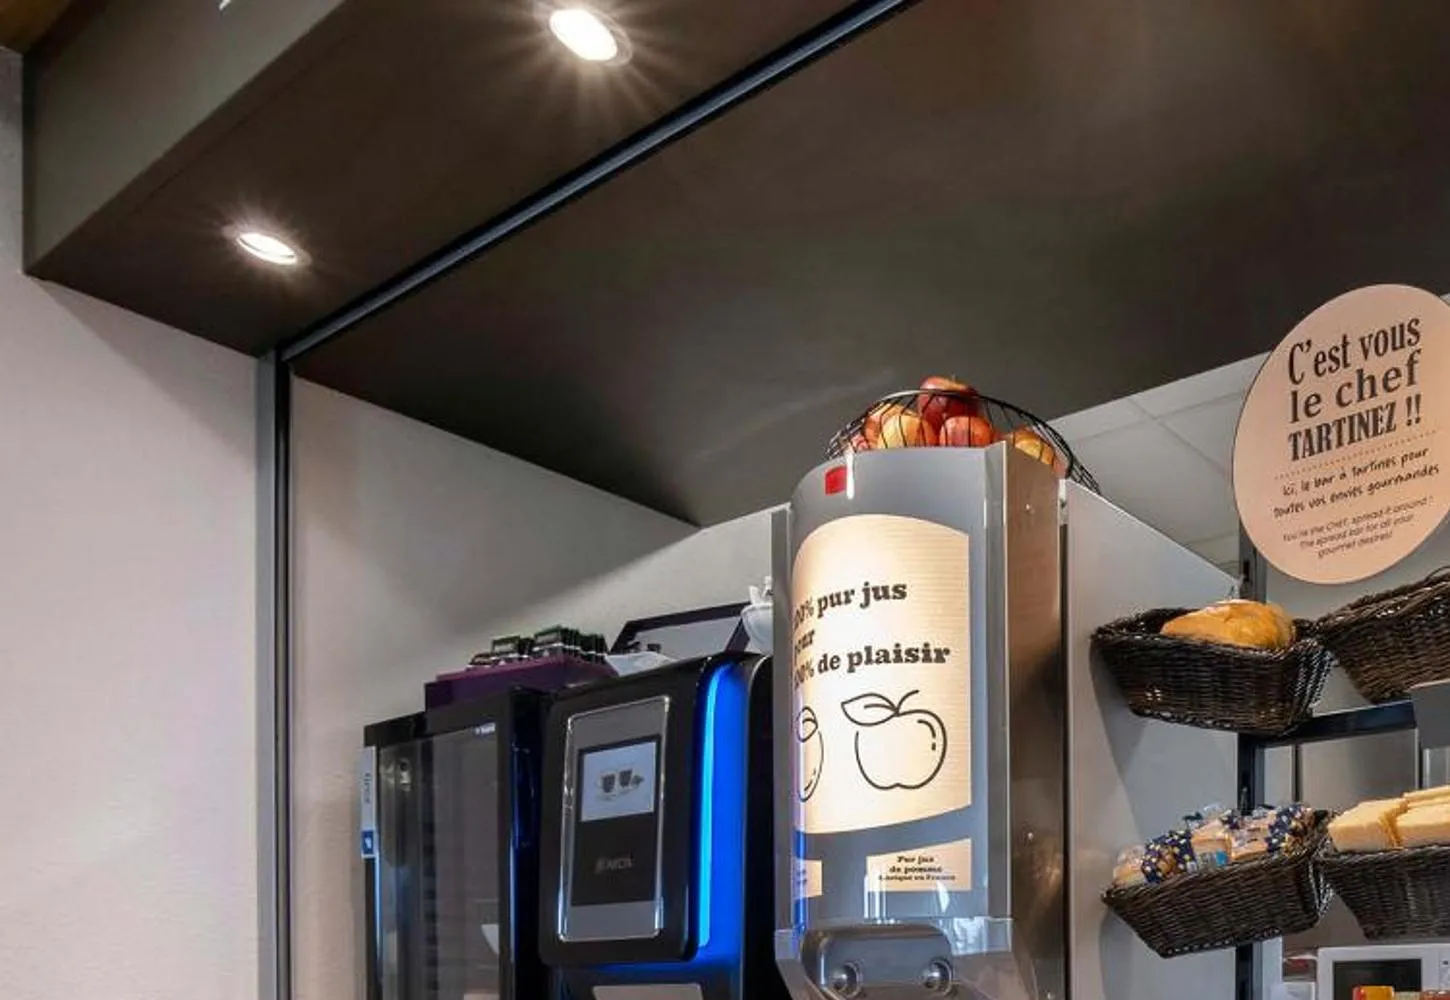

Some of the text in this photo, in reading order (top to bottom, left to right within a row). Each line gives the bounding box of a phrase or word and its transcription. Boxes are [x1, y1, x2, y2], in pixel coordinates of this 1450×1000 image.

[1358, 317, 1421, 361] vous
[1290, 348, 1422, 424] le chef
[1288, 401, 1398, 461] TARTINEZ
[817, 588, 856, 619] pur
[860, 580, 907, 609] jus
[818, 653, 841, 674] de
[846, 642, 950, 673] plaisir
